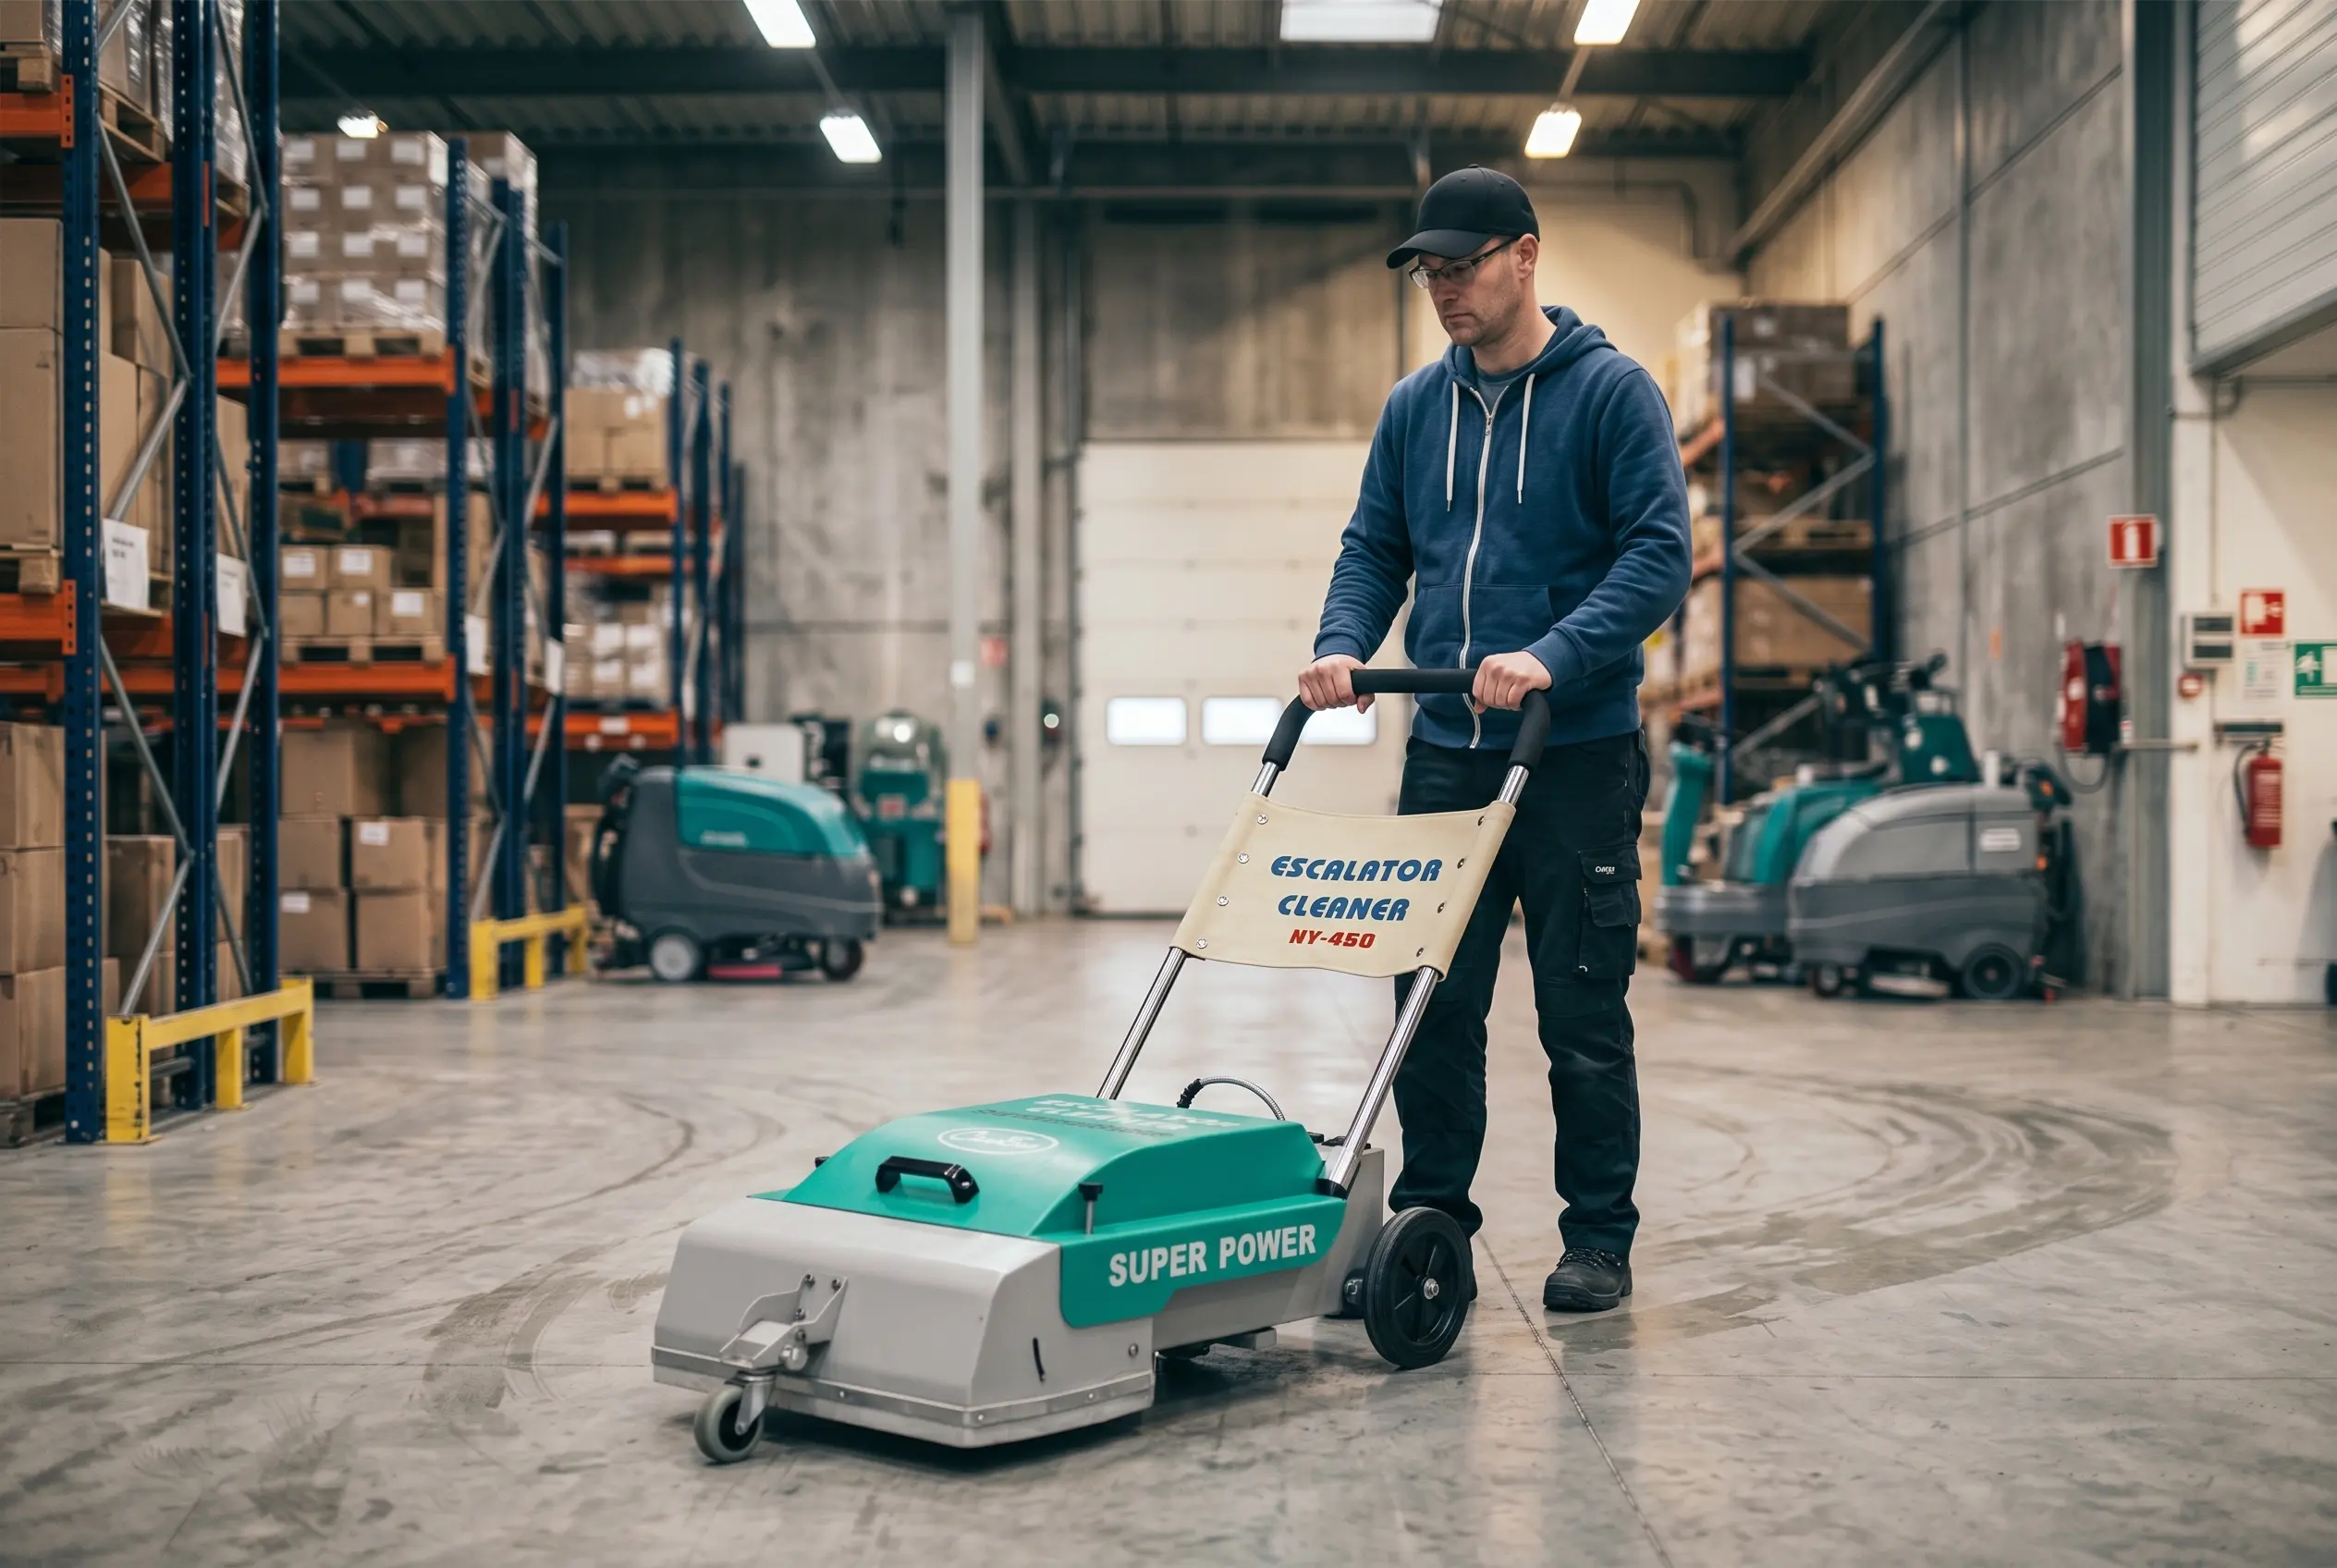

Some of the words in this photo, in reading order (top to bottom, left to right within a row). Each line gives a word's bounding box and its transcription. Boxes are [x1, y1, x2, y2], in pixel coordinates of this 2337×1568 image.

[1270, 855, 1443, 882] ESCALATOR
[1278, 894, 1410, 921] CLEANER
[1290, 929, 1376, 949] NY-450
[1108, 1241, 1207, 1287] SUPER
[1219, 1224, 1316, 1269] POWER
